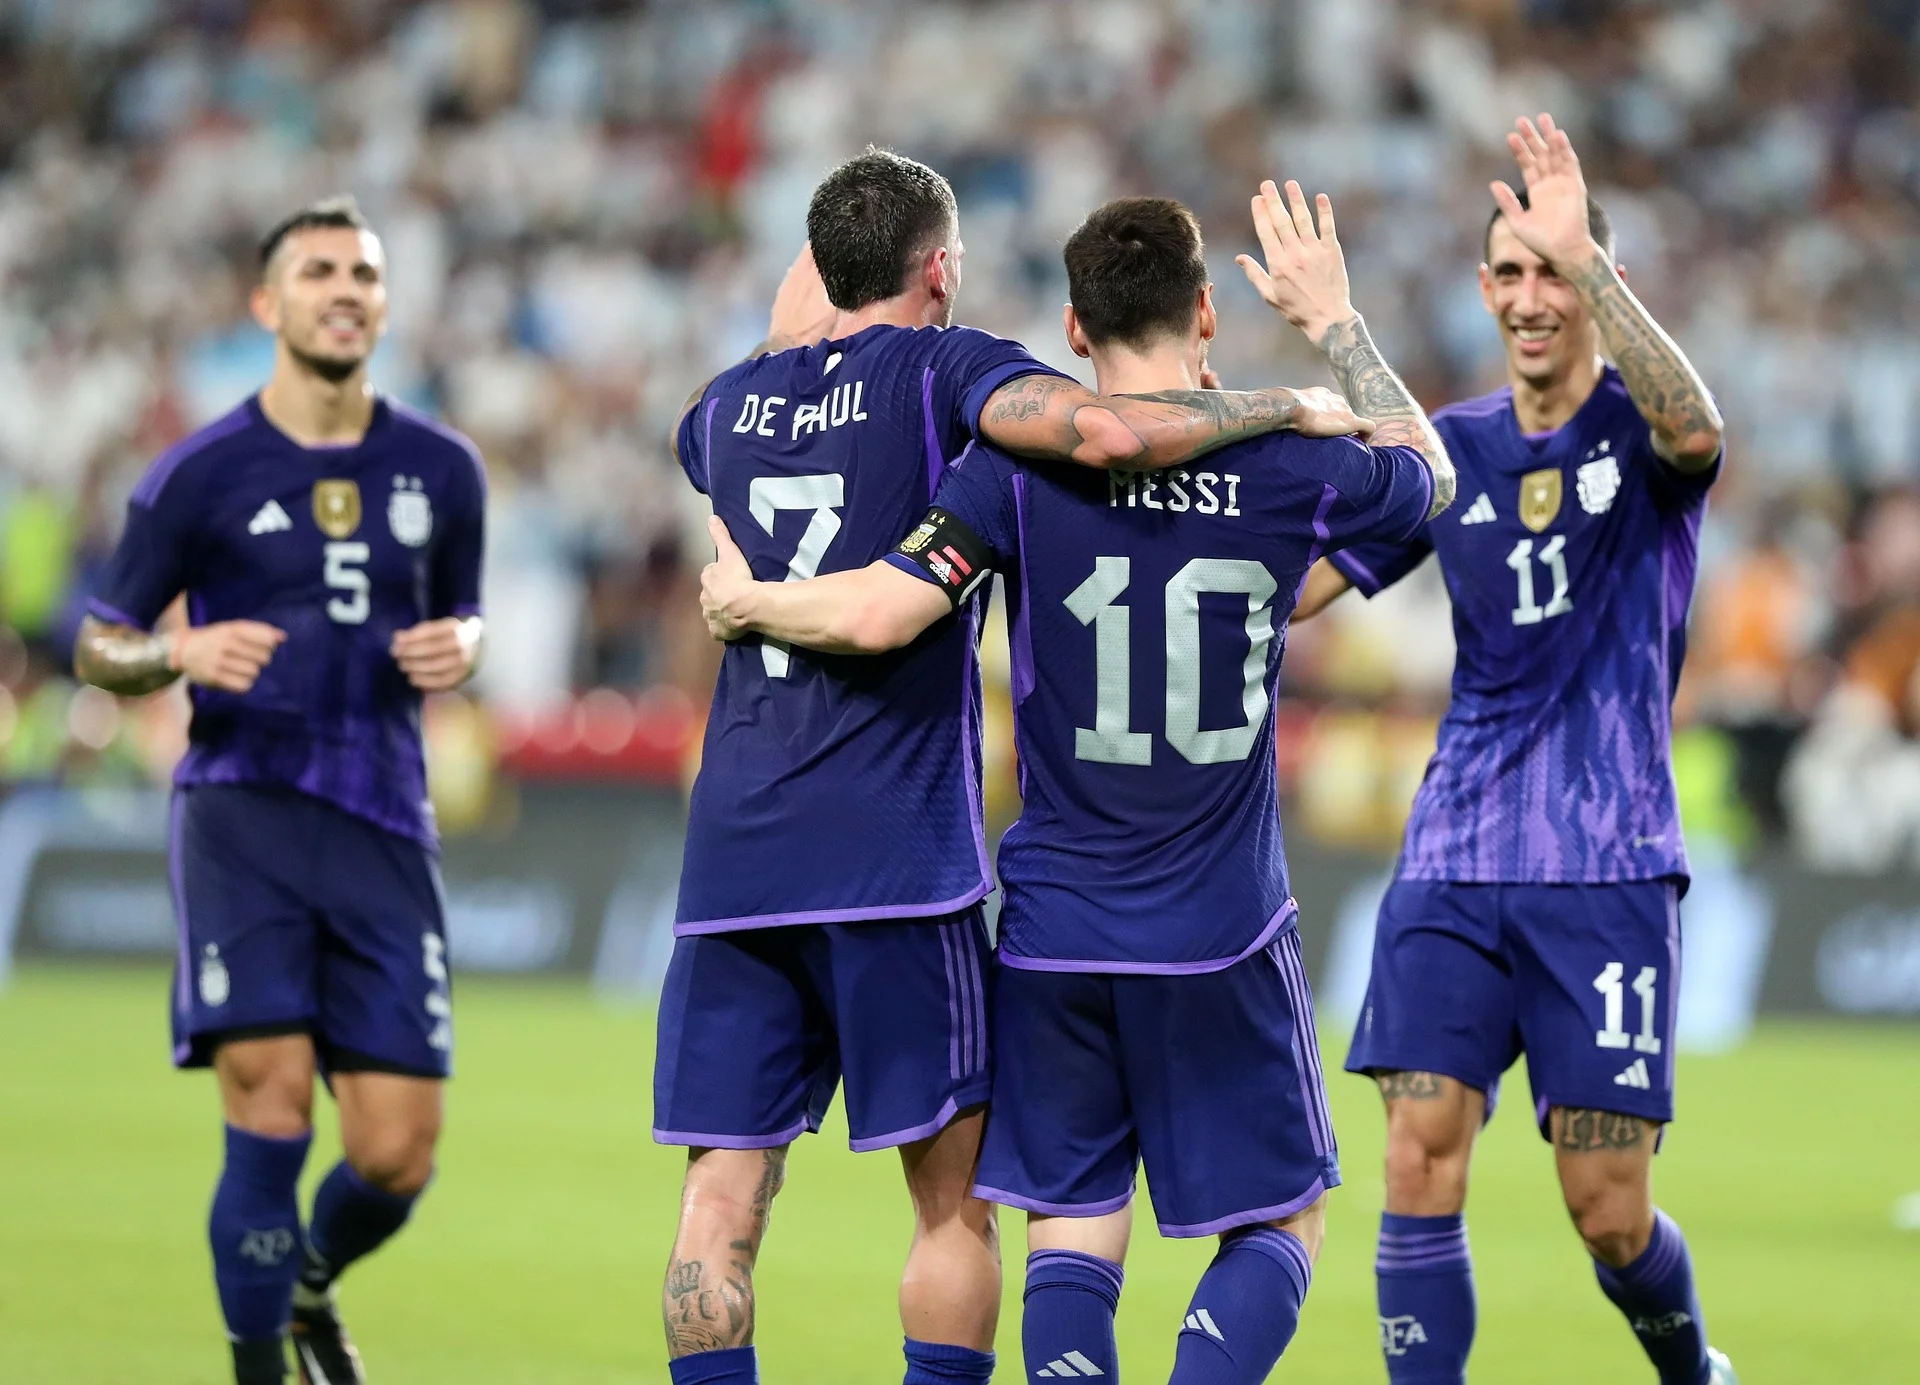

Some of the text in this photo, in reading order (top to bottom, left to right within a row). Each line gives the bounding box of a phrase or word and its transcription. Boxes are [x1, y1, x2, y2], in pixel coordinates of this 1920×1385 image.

[732, 380, 868, 441] DE PAUL
[1109, 468, 1241, 517] MESSI
[323, 541, 371, 625] 5
[749, 473, 844, 678] 7
[929, 563, 950, 584] adidas
[1506, 535, 1574, 626] 11
[1062, 556, 1278, 766] 10
[1592, 961, 1661, 1055] 11
